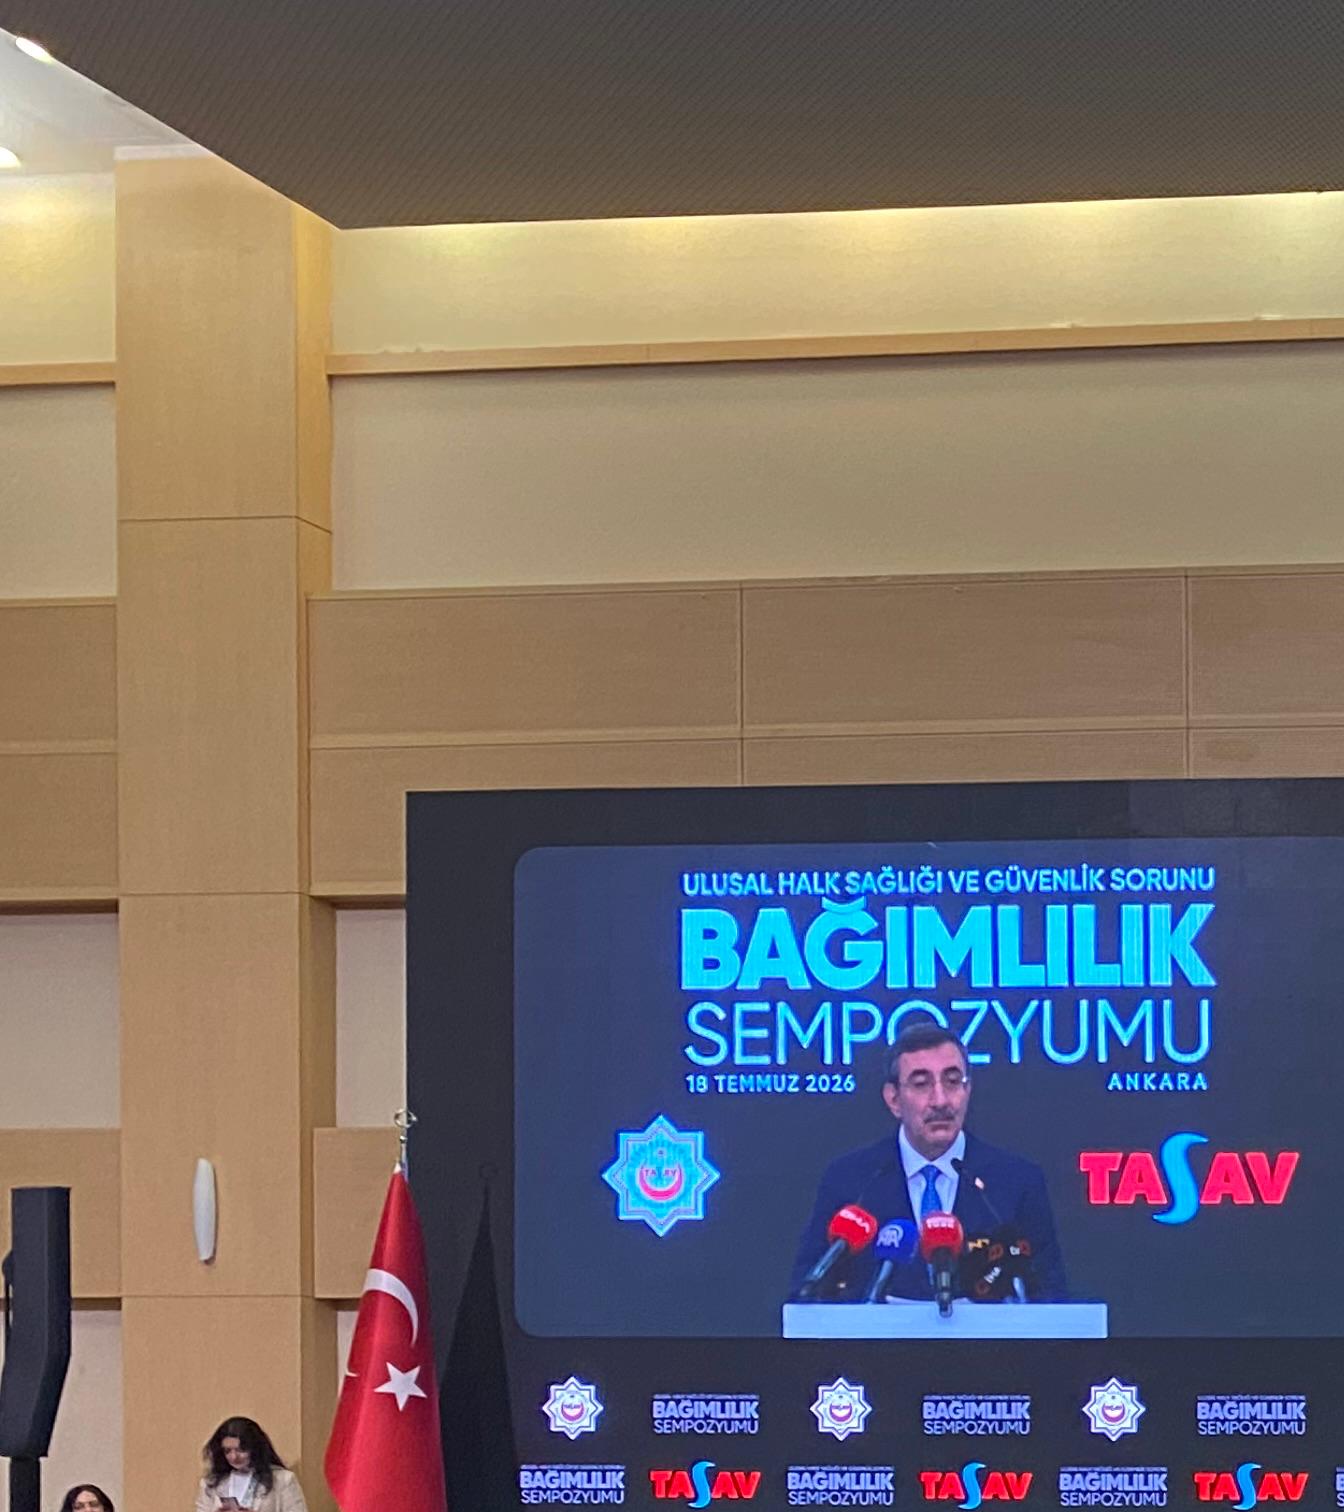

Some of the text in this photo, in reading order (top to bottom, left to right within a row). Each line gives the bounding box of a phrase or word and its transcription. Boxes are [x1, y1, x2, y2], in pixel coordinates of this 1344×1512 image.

[684, 864, 1214, 898] ULUSAL HALK SAĞLIĞI VE GÜVENLİK SORUNU
[682, 897, 1216, 990] BAĞIMLILIK
[685, 999, 1208, 1067] SEMPOZYUMU
[686, 1074, 855, 1092] 18 TEMMUZ 2026
[1108, 1073, 1207, 1090] ANKARA
[1080, 1134, 1299, 1221] TASAV
[653, 1400, 759, 1418] BAĞIMLILIK
[923, 1401, 1030, 1419] BAĞIMLILIK
[1197, 1401, 1306, 1419] BAĞIMLILIK
[654, 1420, 758, 1434] SEMPOZYUMU
[924, 1421, 1030, 1434] SEMPOZYUMU
[1198, 1421, 1305, 1435] SEMPOZYUMU
[520, 1470, 625, 1491] BAĞIMLILIK
[650, 1462, 761, 1507] TASAV
[788, 1472, 894, 1492] BAĞIMLILIK
[920, 1463, 1032, 1509] TASAV
[1060, 1472, 1167, 1491] BAĞIMLILIK
[1194, 1464, 1308, 1510] TASAV
[521, 1490, 624, 1504] SEMPOZYUMU
[789, 1492, 893, 1505] SEMPOZYUMU
[1061, 1492, 1166, 1506] SEMPOZYUMU
